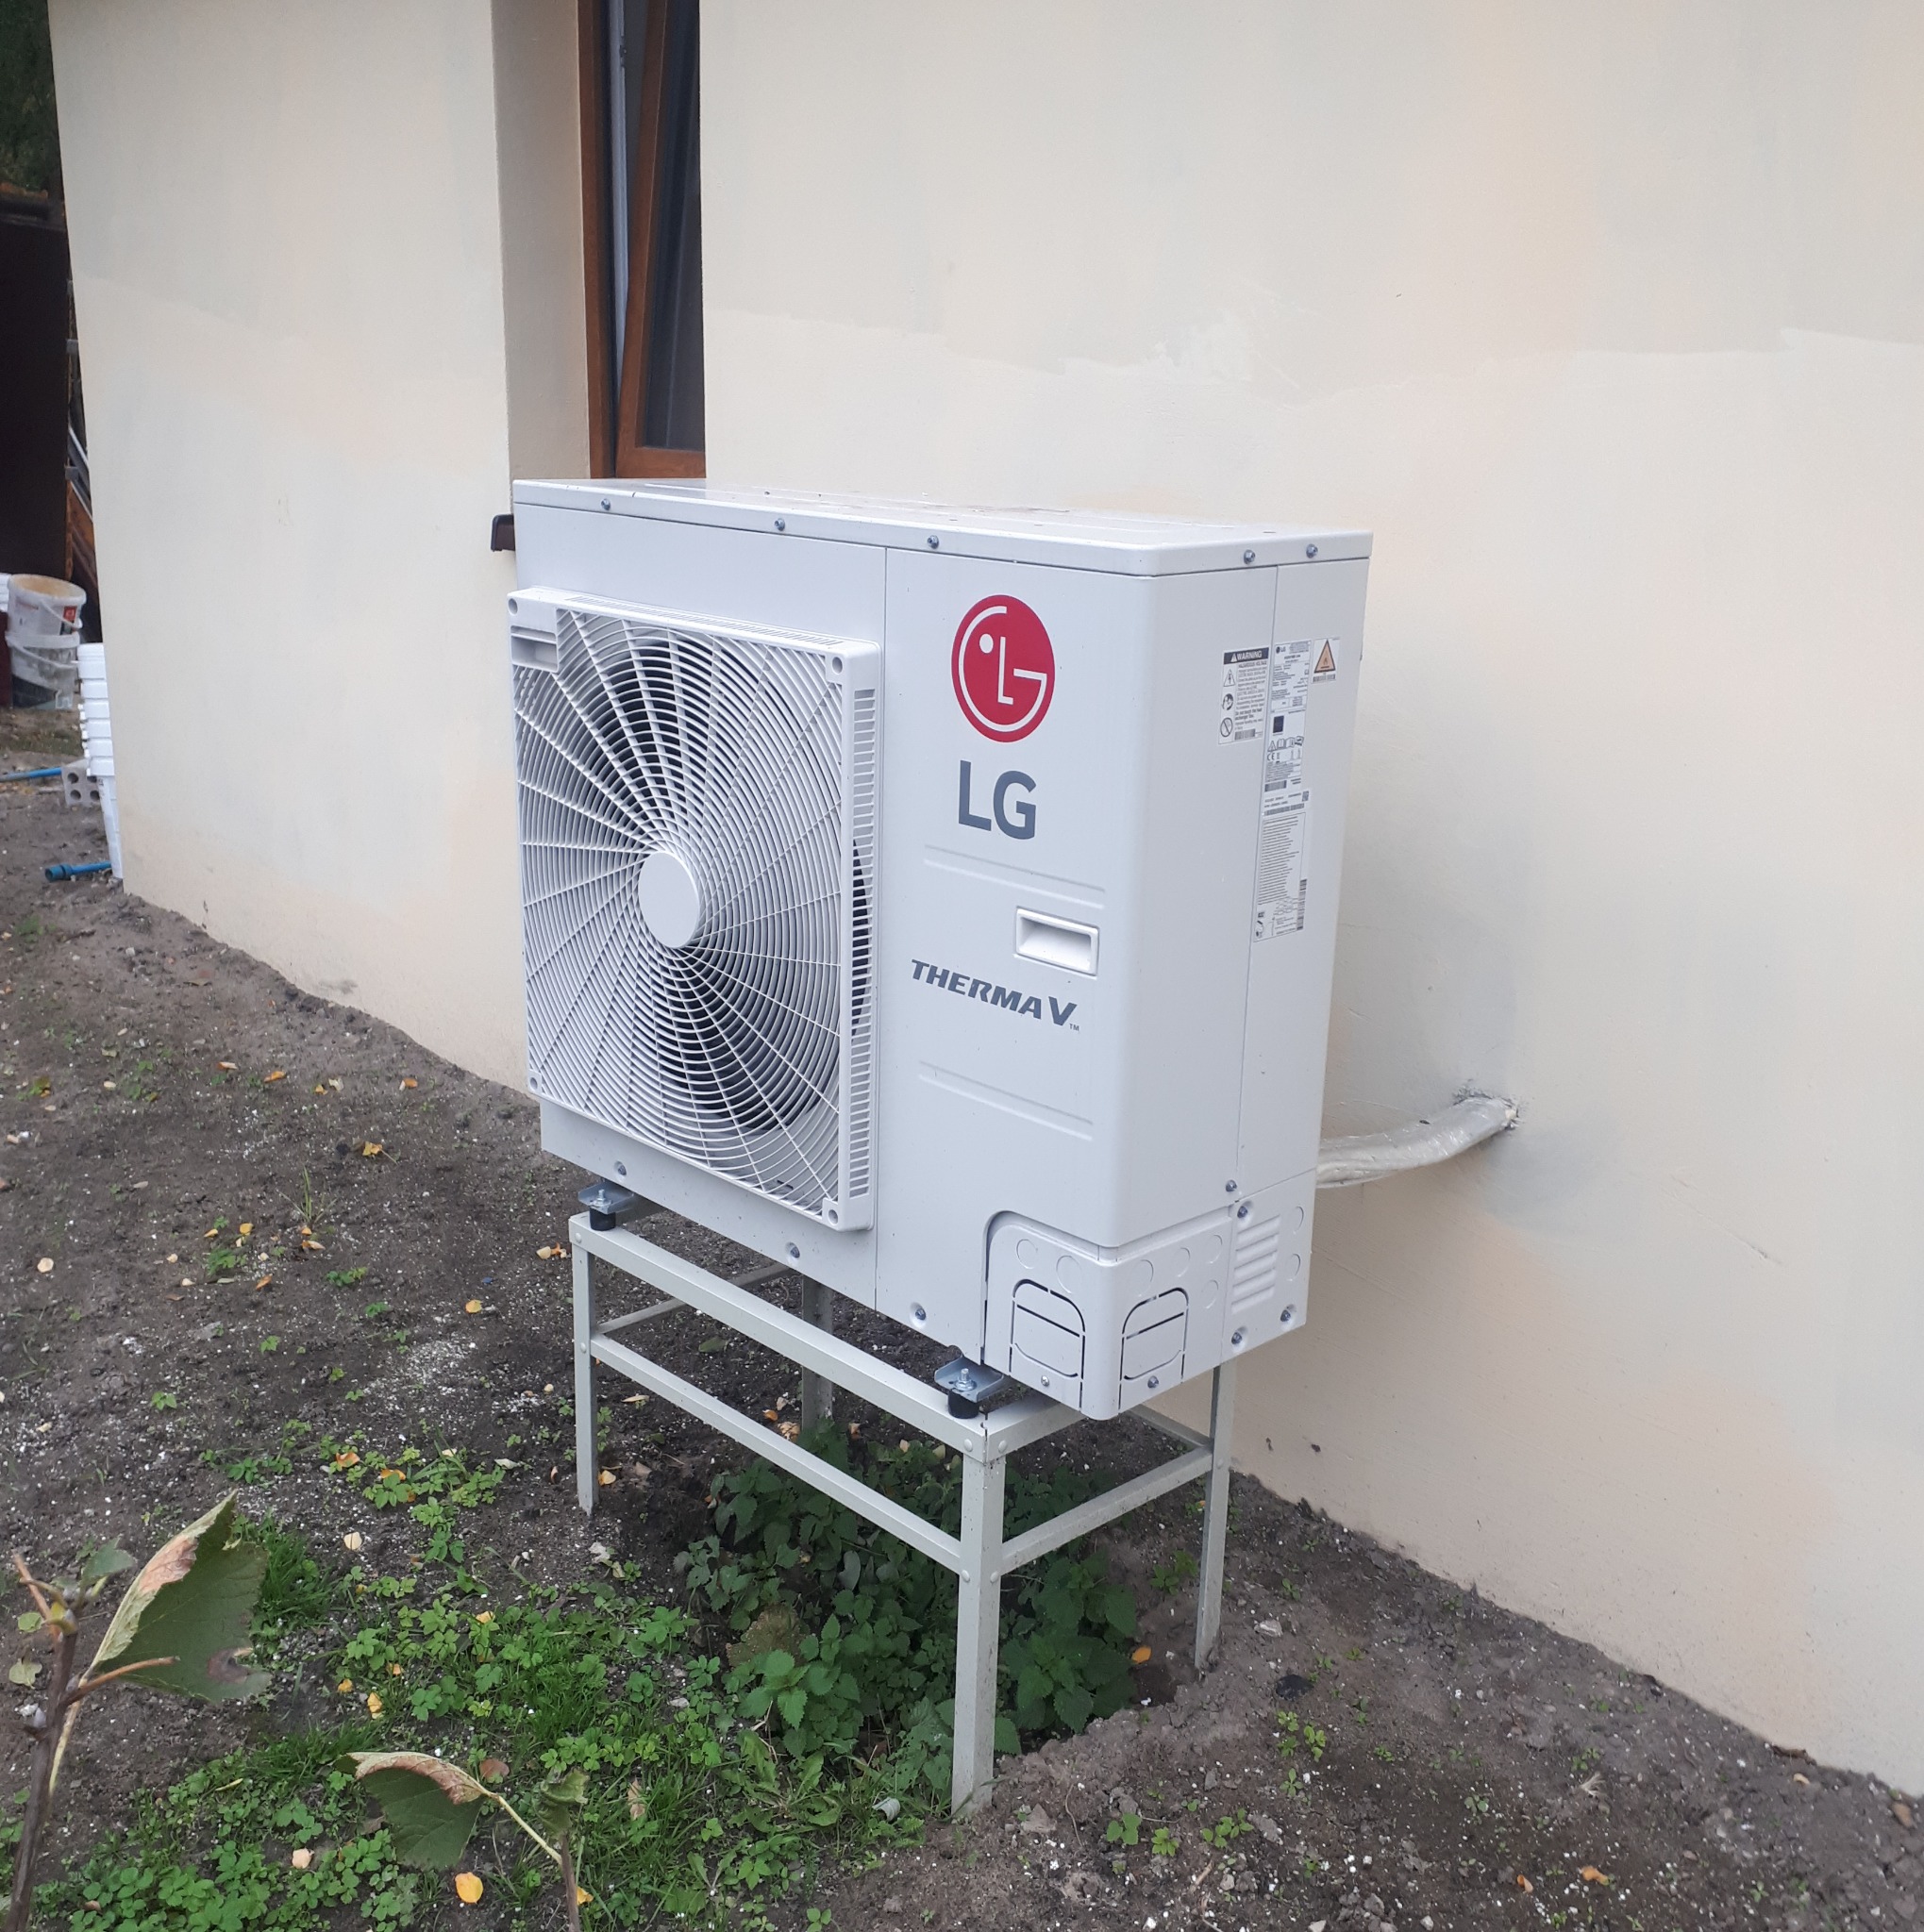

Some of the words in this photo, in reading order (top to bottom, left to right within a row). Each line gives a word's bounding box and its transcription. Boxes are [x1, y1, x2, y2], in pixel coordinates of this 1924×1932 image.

[1237, 650, 1263, 661] WARNING
[959, 760, 1036, 840] LG
[912, 958, 1042, 1020] THERMA
[1048, 996, 1078, 1026] V
